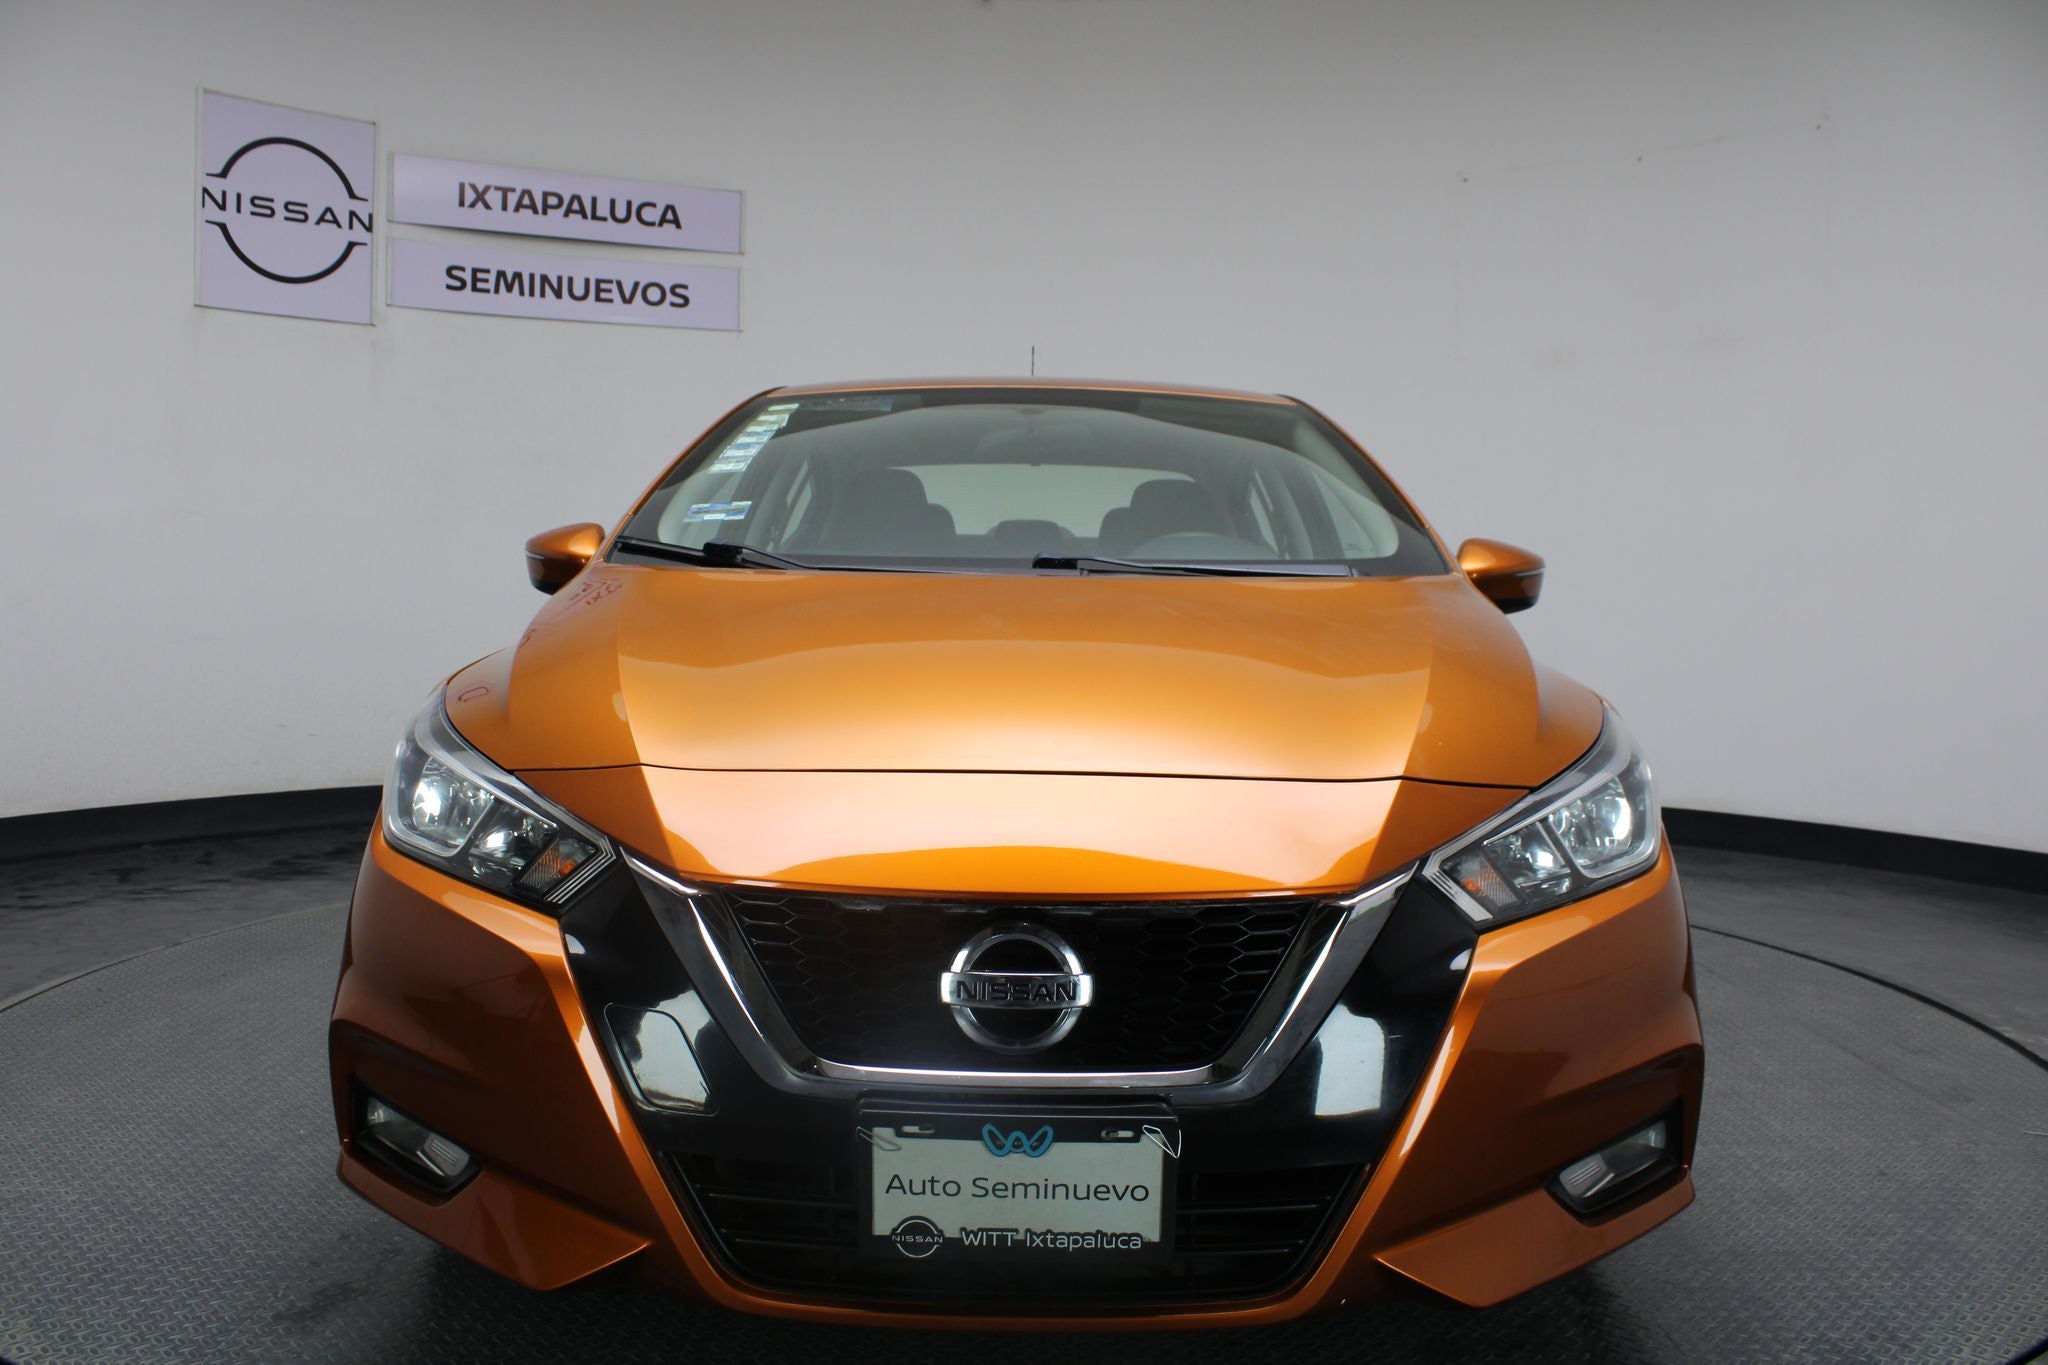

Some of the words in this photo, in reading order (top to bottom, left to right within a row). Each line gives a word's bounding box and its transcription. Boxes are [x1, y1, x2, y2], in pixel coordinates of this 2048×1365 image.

[202, 186, 373, 233] NISSAN
[458, 181, 682, 230] IXTAPALUCA
[445, 265, 690, 308] SEMINUEVOS
[956, 980, 1076, 1002] NISSAN
[885, 1174, 961, 1198] Auto
[971, 1177, 1150, 1202] Seminuevo
[892, 1235, 943, 1243] NISSAN
[962, 1231, 1017, 1247] WITT
[1026, 1231, 1142, 1252] Ixtapaluca
